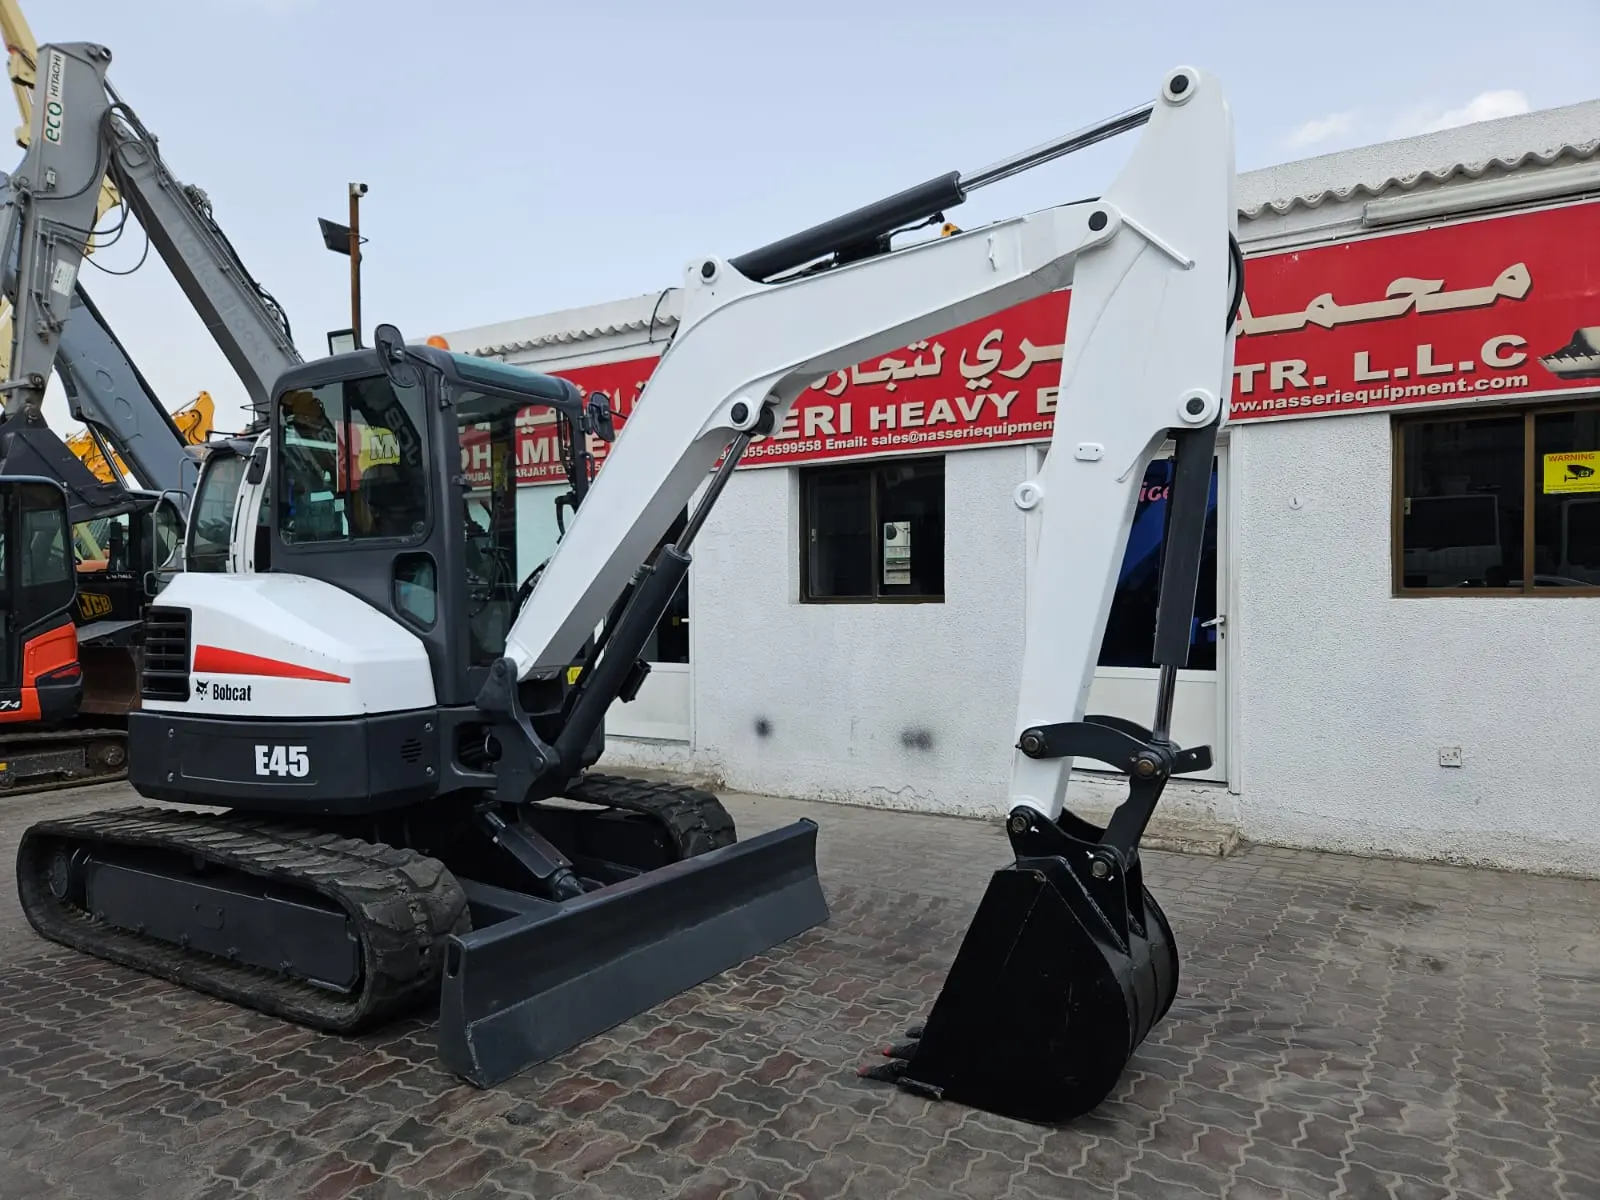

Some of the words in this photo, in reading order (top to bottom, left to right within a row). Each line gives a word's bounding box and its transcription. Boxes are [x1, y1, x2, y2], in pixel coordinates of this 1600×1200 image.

[50, 54, 62, 97] HITACHI
[45, 101, 63, 142] eco
[869, 390, 1019, 430] HEAVY
[1354, 334, 1528, 382] L.L.C
[826, 437, 868, 449] Email:
[871, 421, 1054, 446] sales@nasseriequipmen
[1548, 453, 1595, 461] WARNING
[82, 594, 110, 617] JCB
[212, 684, 252, 701] Bobcat
[254, 745, 310, 777] E45
